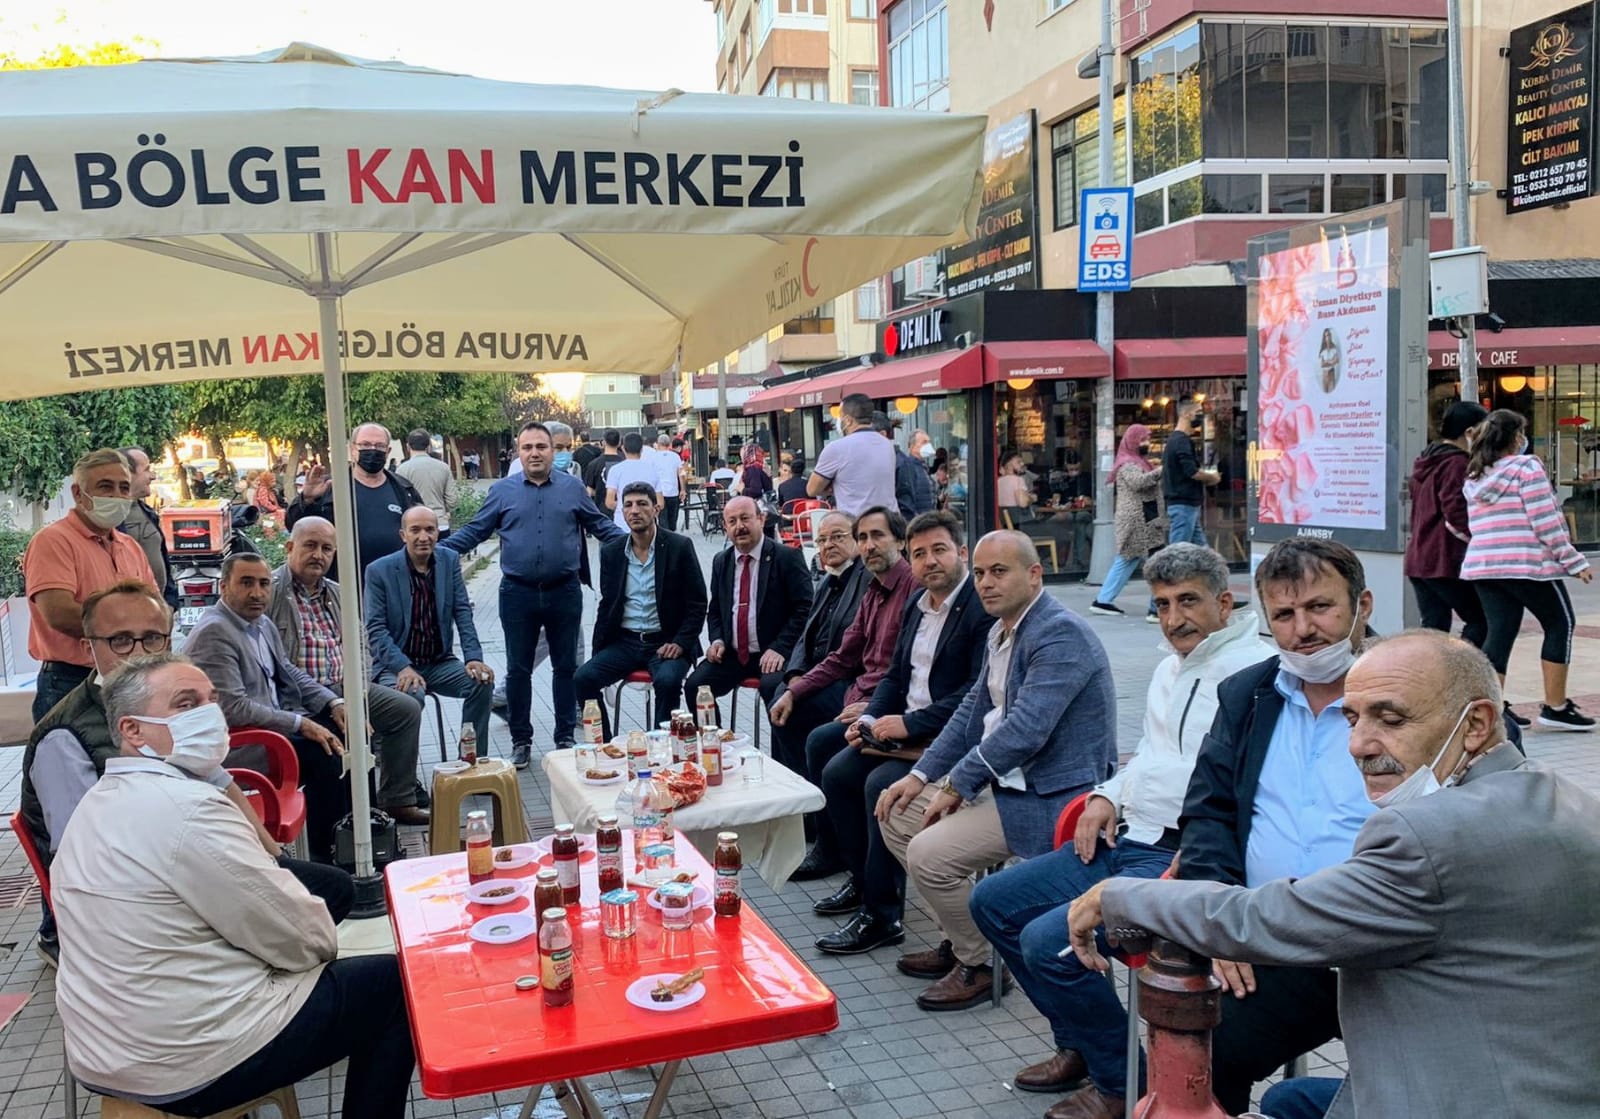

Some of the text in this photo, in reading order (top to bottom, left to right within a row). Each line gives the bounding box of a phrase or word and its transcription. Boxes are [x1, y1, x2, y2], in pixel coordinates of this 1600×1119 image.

[1517, 77, 1587, 106] BEAUTY CENTER
[1515, 93, 1588, 126] KALICI MAKYAJ
[1522, 116, 1580, 145] İPEK KİRPİK
[1522, 140, 1580, 166] CİLT BAKIMI
[0, 133, 806, 214] A BÖLGE KAN MERKEZİ
[1513, 158, 1587, 184] TEL: 0212 657 70 45
[1513, 170, 1587, 195] TEL: 0533 350 70 97
[985, 208, 1023, 236] CENTER
[1083, 262, 1127, 281] EDS
[1337, 303, 1376, 317] Akduman
[1340, 290, 1382, 306] Diyetisyen
[900, 307, 942, 351] DEMLİK
[1490, 351, 1518, 366] CAFE
[1296, 527, 1334, 540] AJANSBY
